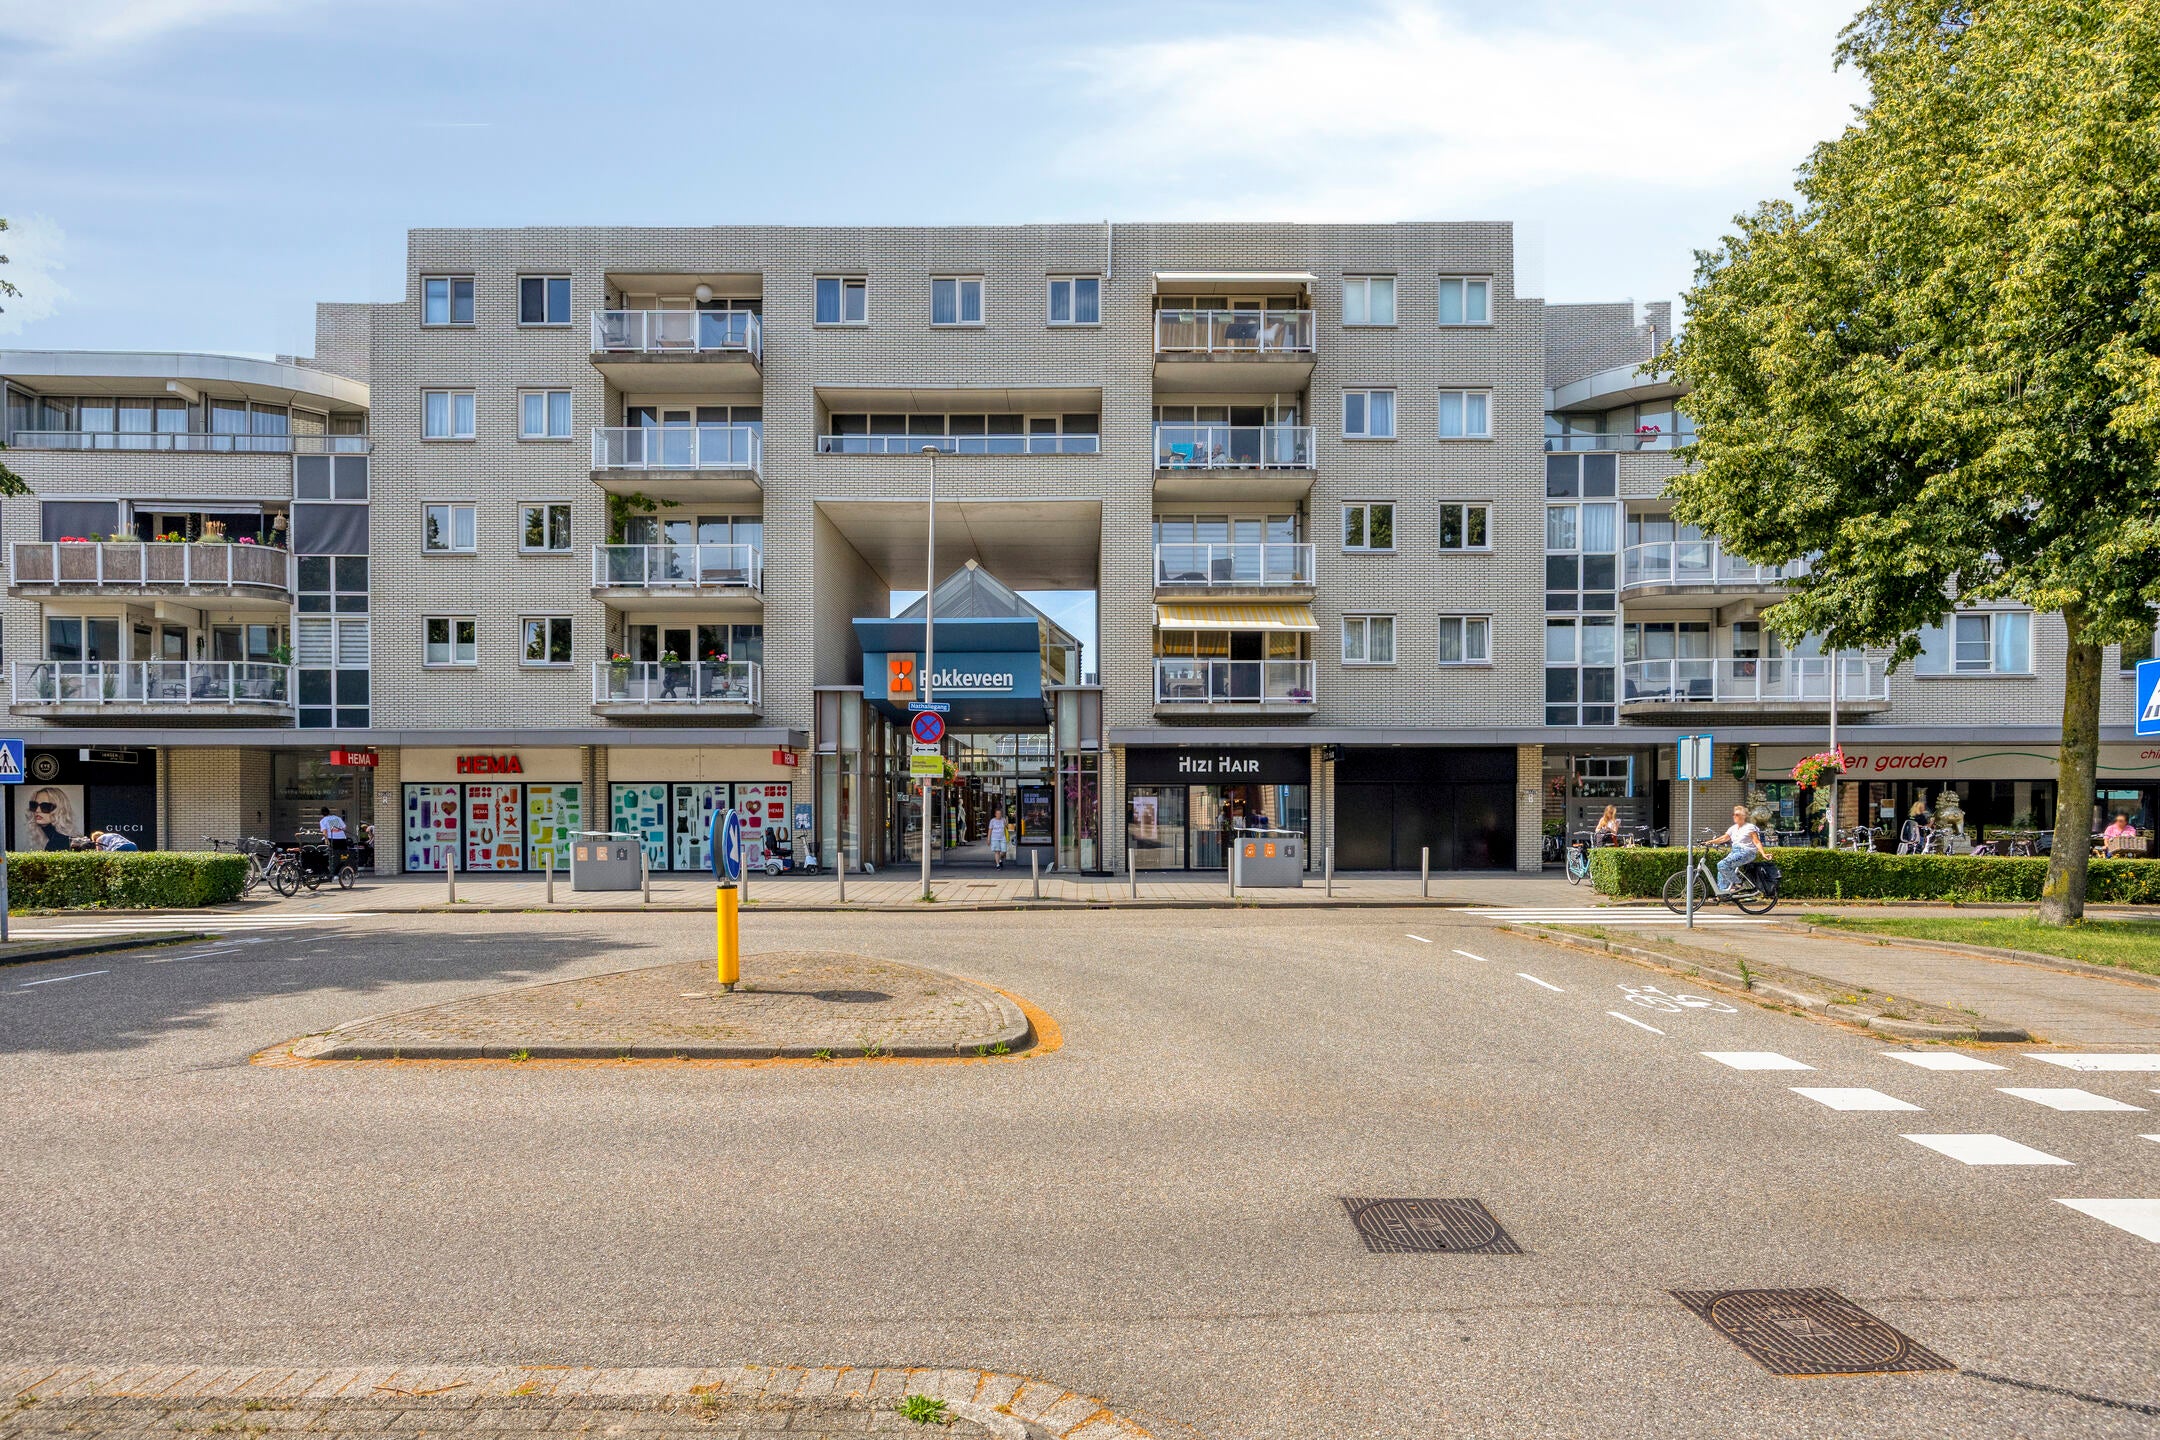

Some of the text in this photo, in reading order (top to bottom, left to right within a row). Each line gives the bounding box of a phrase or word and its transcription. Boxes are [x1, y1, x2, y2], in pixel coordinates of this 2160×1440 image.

[347, 753, 371, 765] HEMA
[456, 755, 523, 774] HEMA
[1178, 756, 1260, 772] HIZI HAIR
[1874, 753, 1948, 772] garden
[106, 824, 143, 832] GUCCI
